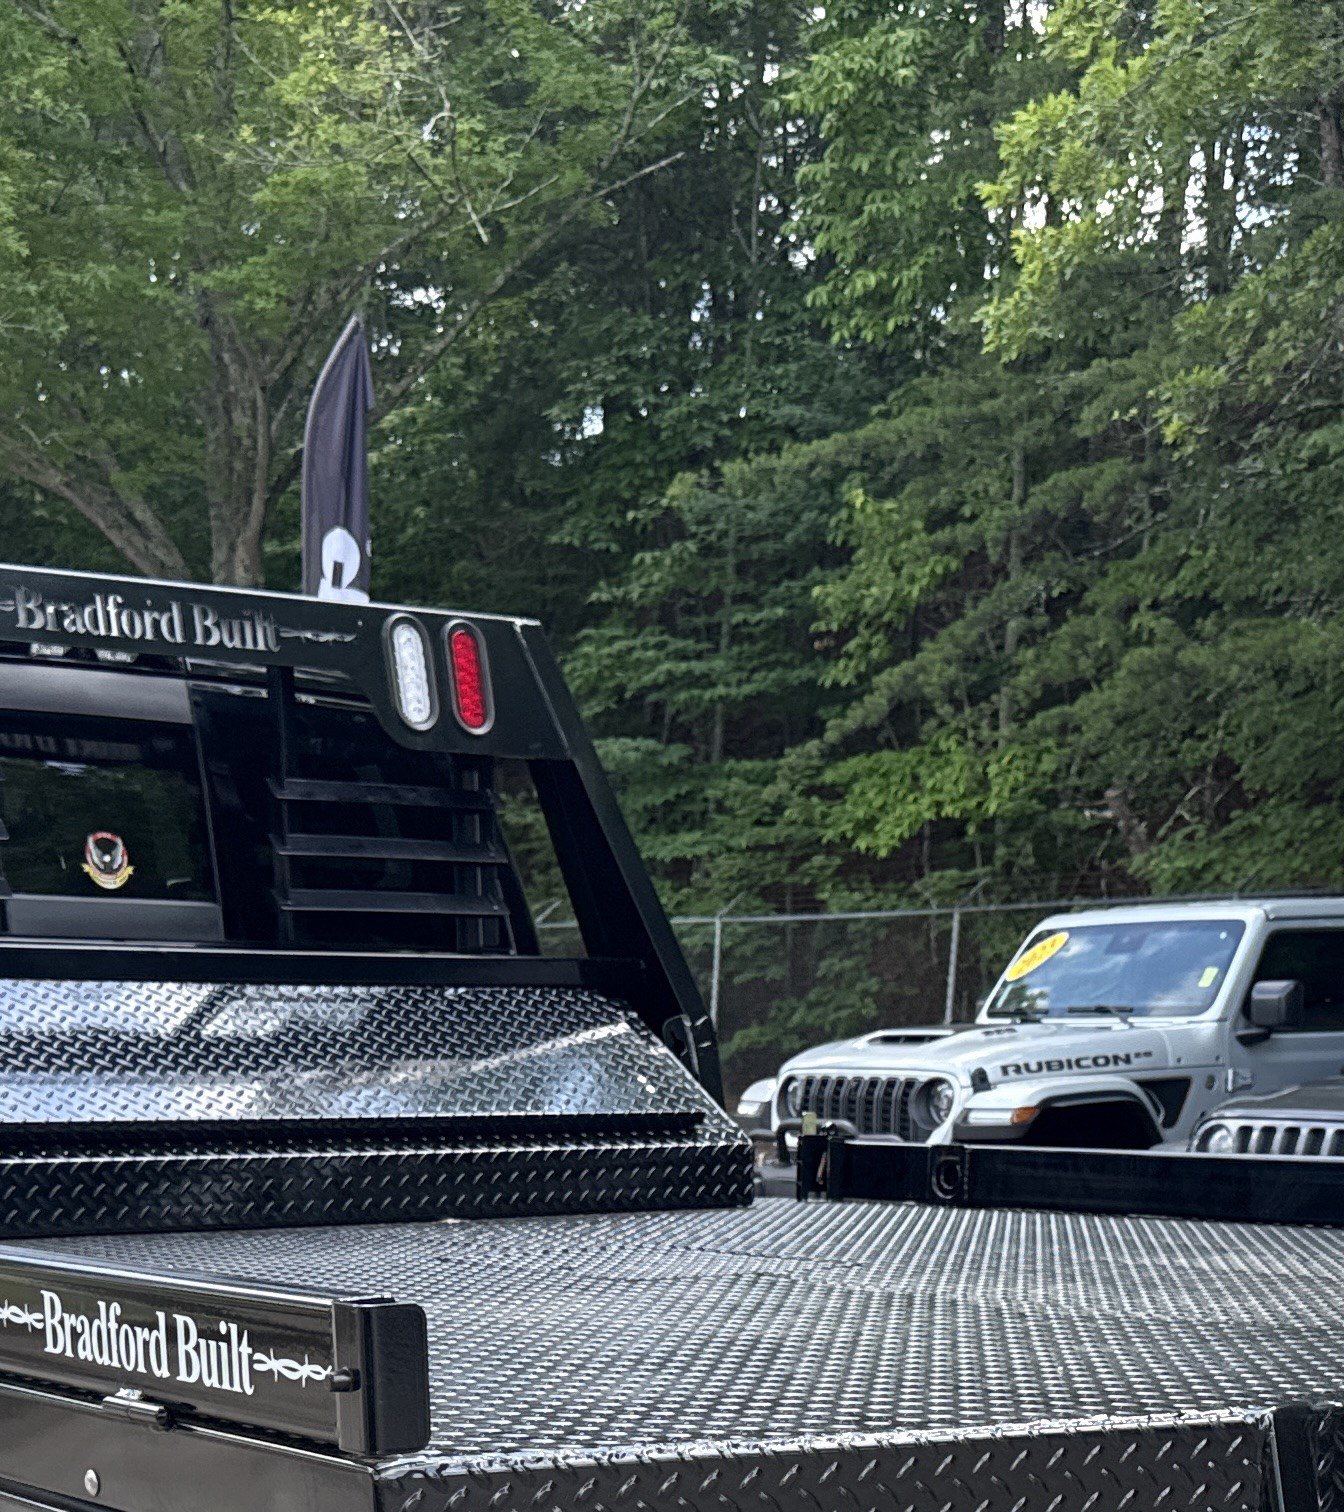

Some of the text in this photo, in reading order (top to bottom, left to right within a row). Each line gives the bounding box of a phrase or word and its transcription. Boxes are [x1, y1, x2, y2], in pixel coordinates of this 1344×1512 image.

[14, 586, 282, 653] Bradford Built
[1000, 1053, 1132, 1077] RUBICON
[40, 1289, 256, 1396] Bradford Built
